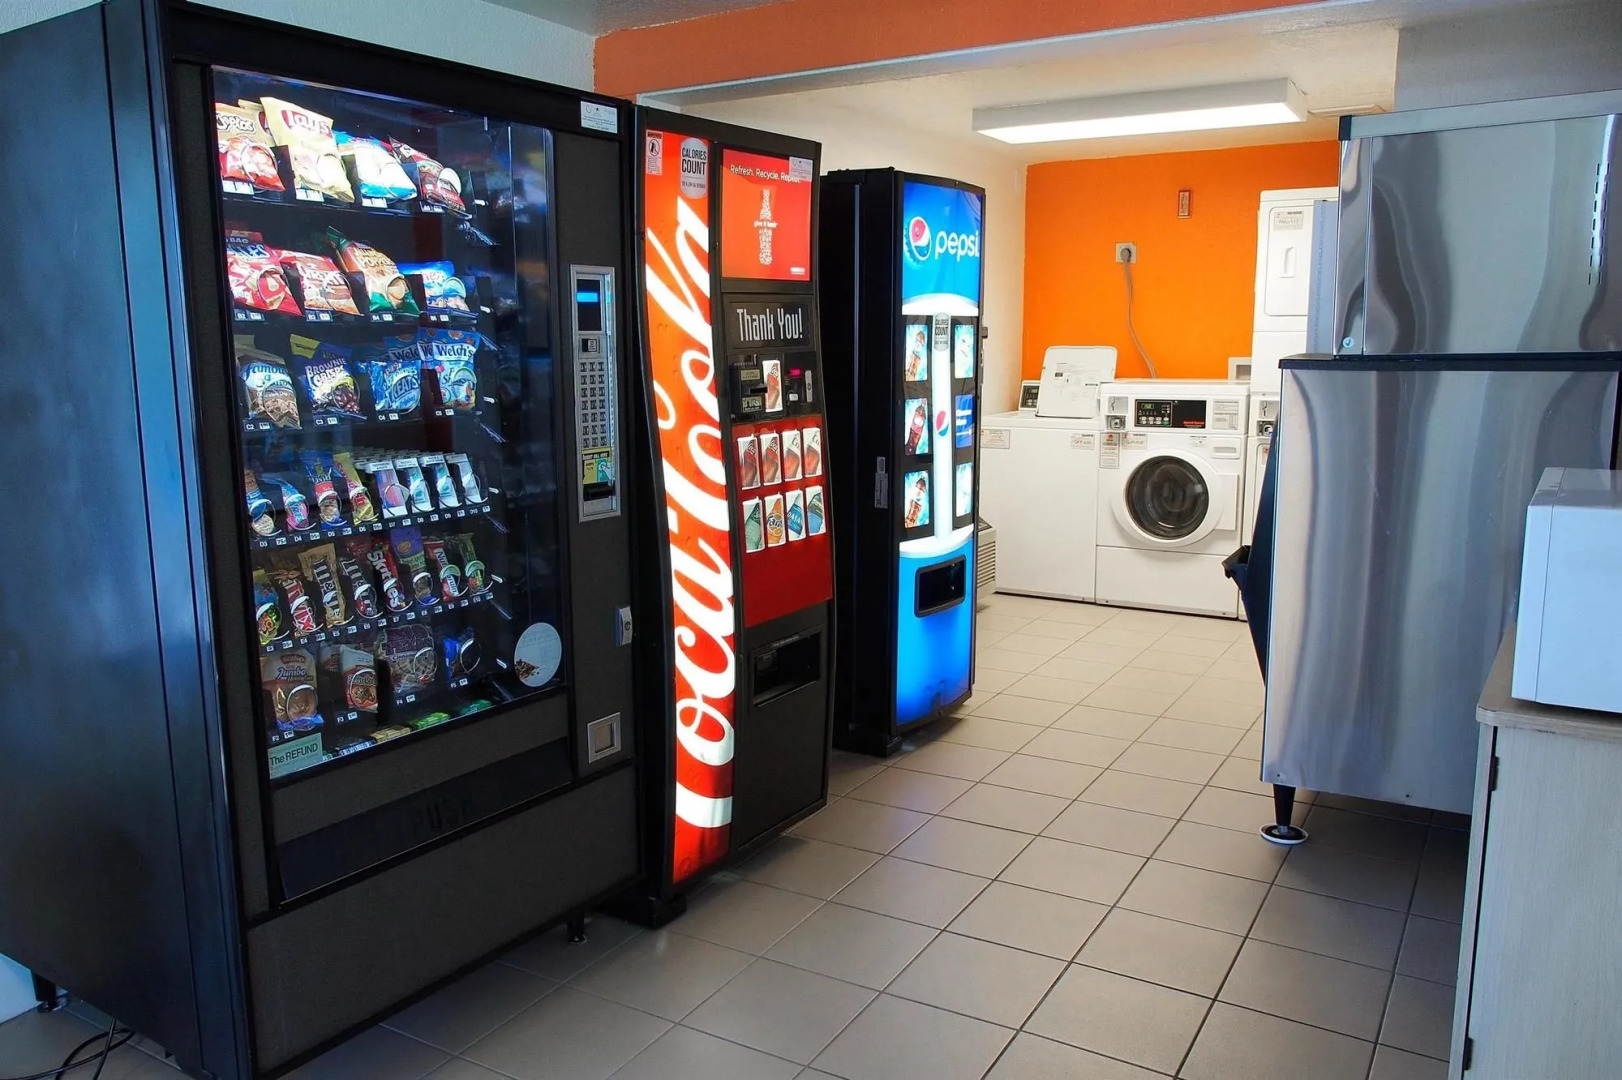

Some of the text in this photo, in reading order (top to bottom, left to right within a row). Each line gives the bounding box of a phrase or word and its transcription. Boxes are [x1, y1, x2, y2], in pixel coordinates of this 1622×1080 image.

[682, 147, 707, 160] CALORIES
[682, 159, 706, 175] COUNT
[934, 230, 979, 262] pepsi
[737, 308, 803, 341] Thank You!
[934, 326, 949, 336] COUNT
[437, 345, 474, 358] Welch's
[277, 666, 307, 680] Jumbo
[269, 743, 318, 766] The REFUND
